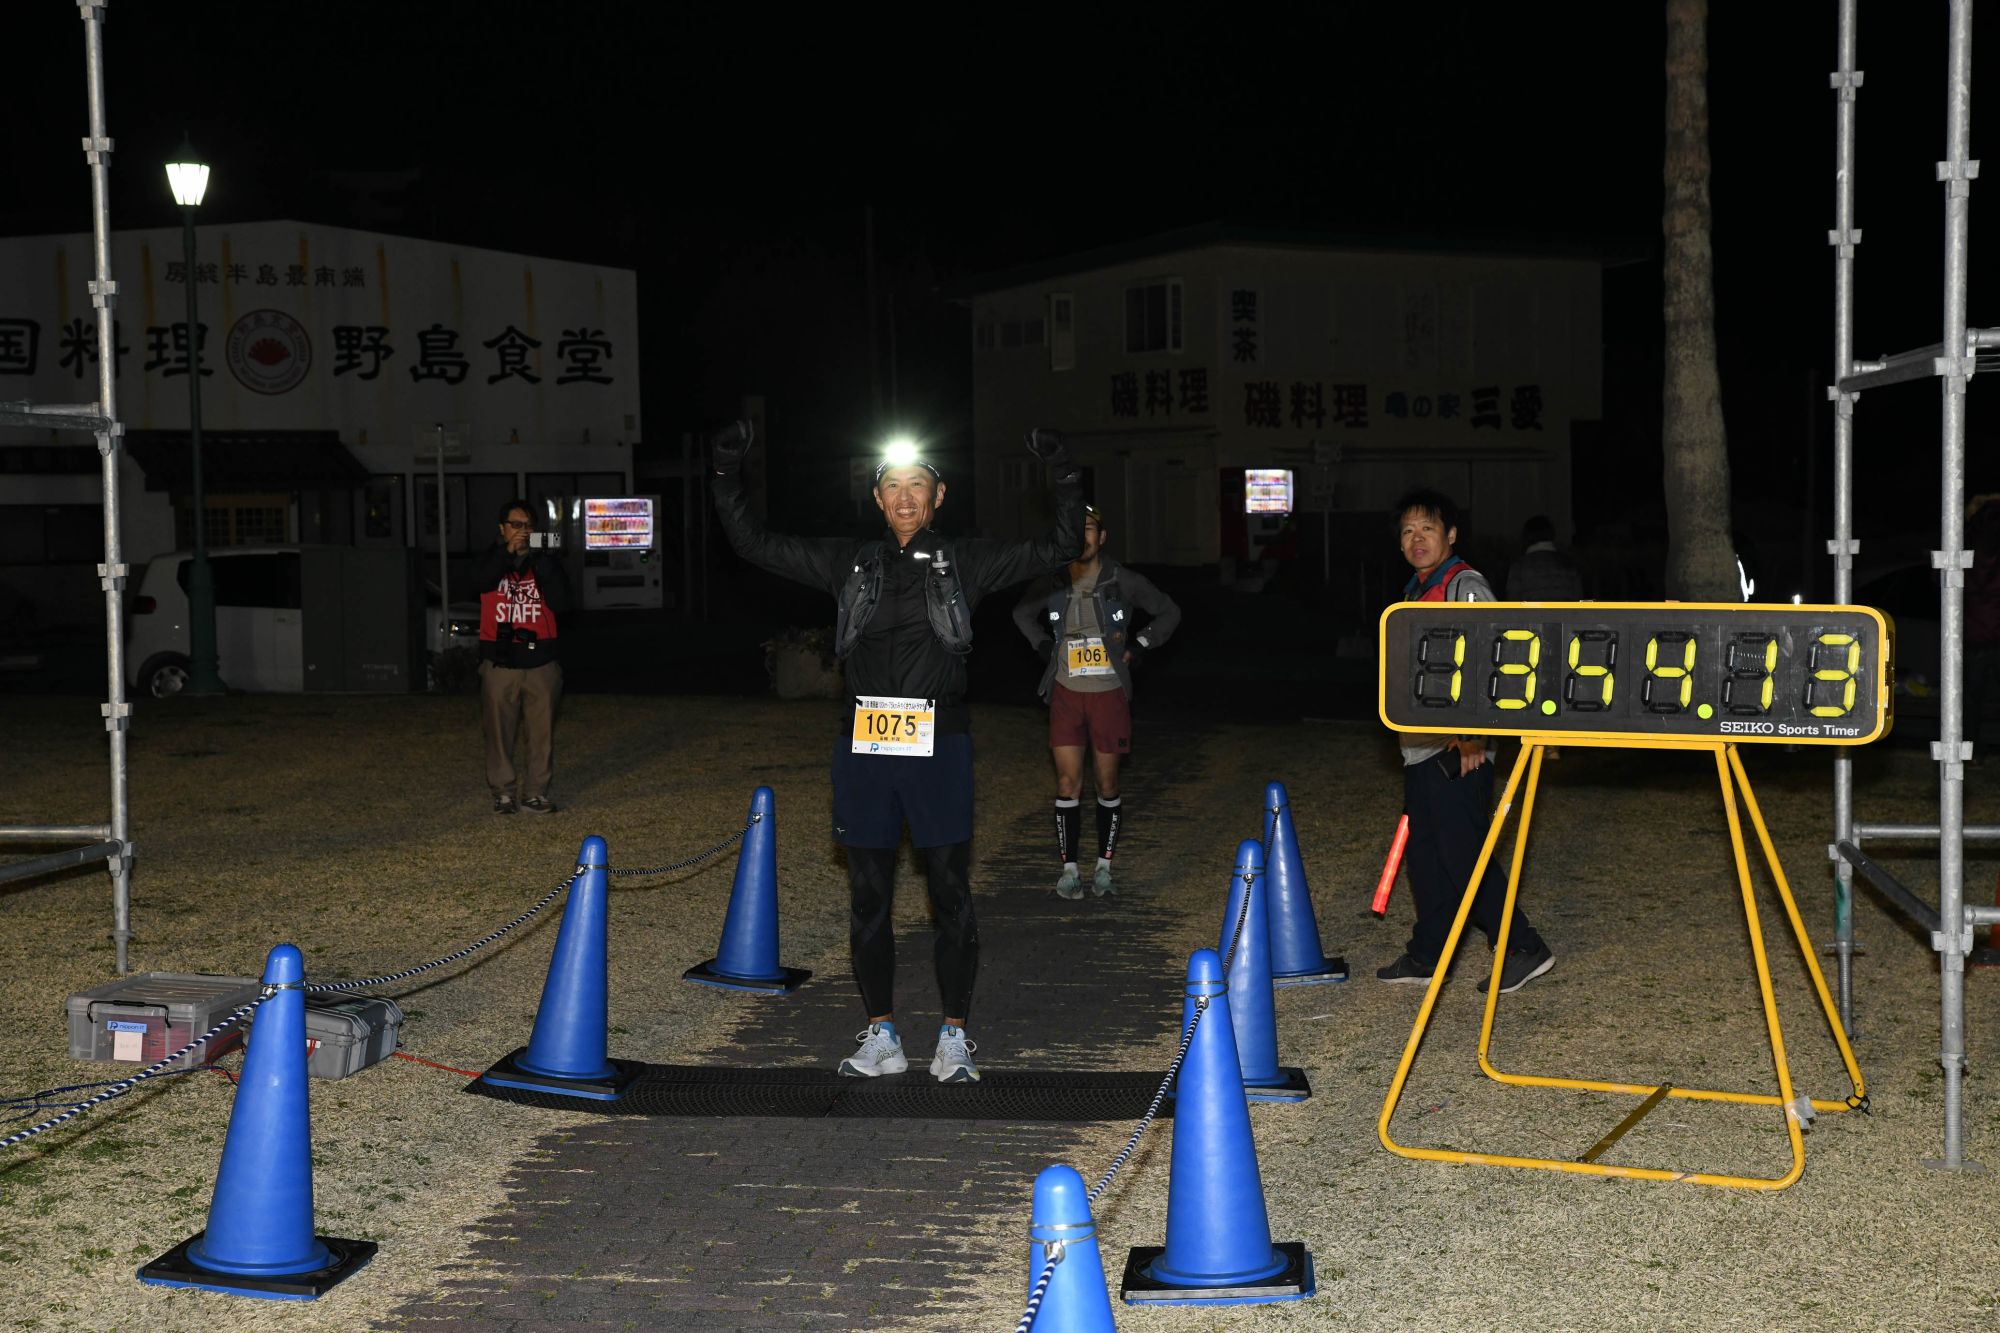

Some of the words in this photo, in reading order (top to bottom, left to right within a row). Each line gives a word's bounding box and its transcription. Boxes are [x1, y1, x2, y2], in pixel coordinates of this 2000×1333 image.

[165, 261, 367, 289] 房総半島最南端
[1232, 288, 1258, 363] 喫茶
[332, 324, 614, 386] 野島食堂
[1111, 367, 1208, 419] 磯料理
[1243, 381, 1369, 430] 磯料理
[496, 603, 541, 623] STAFF
[866, 713, 917, 737] 1075
[1720, 721, 1774, 734] SEIKO
[1778, 723, 1819, 736] Sports
[1823, 724, 1860, 736] Timer
